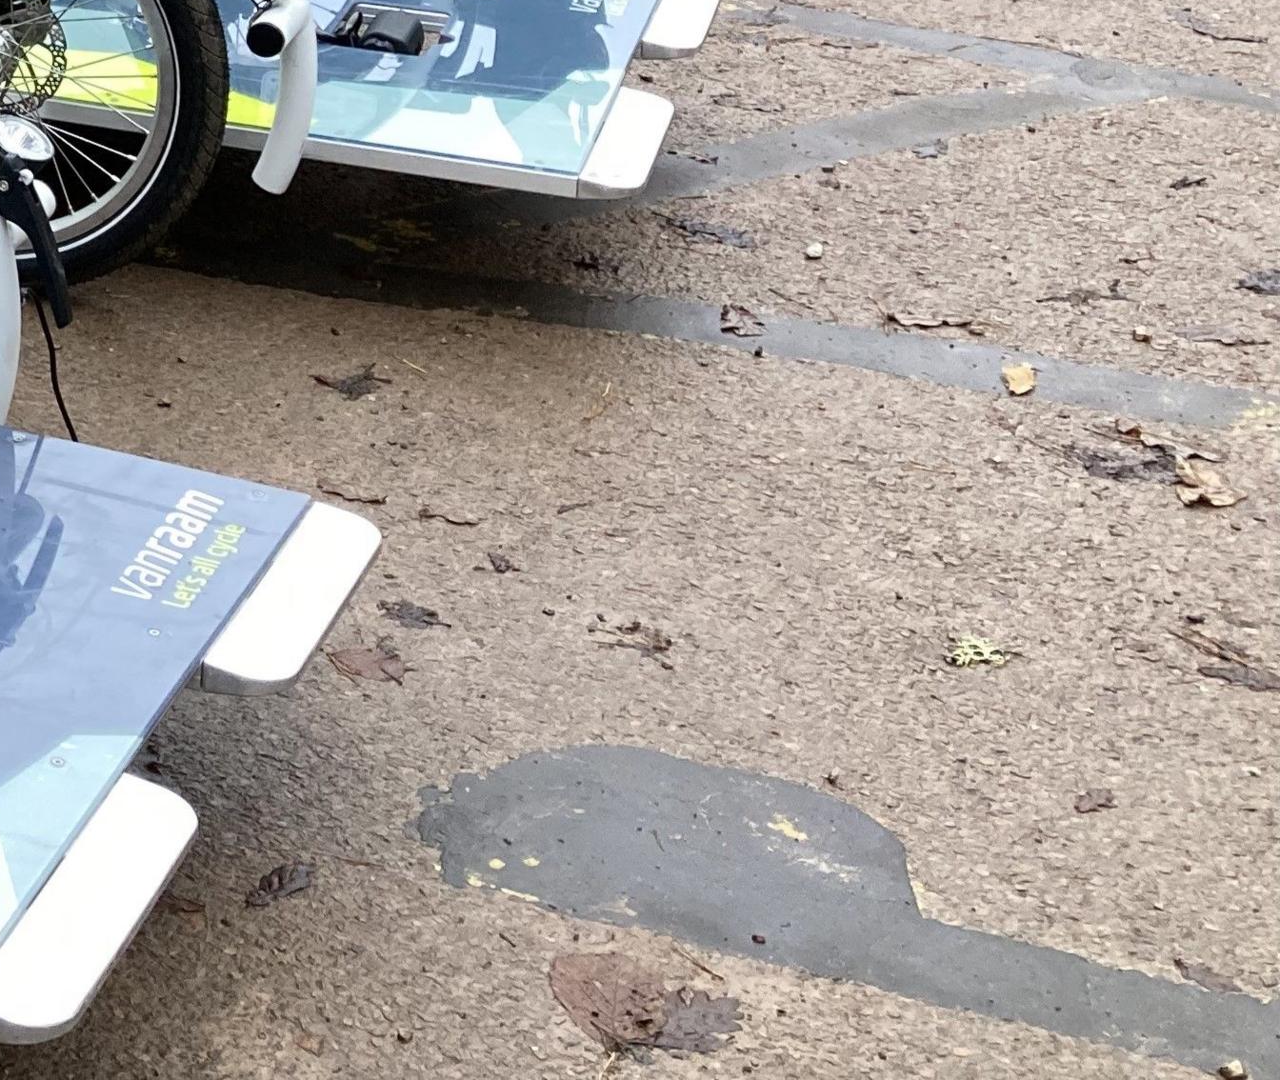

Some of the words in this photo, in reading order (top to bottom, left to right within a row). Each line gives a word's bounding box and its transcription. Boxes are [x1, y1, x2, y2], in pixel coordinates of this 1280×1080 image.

[109, 488, 225, 601] vanraam
[206, 523, 247, 557] cycle
[191, 555, 222, 576] all
[161, 575, 208, 609] Let's
